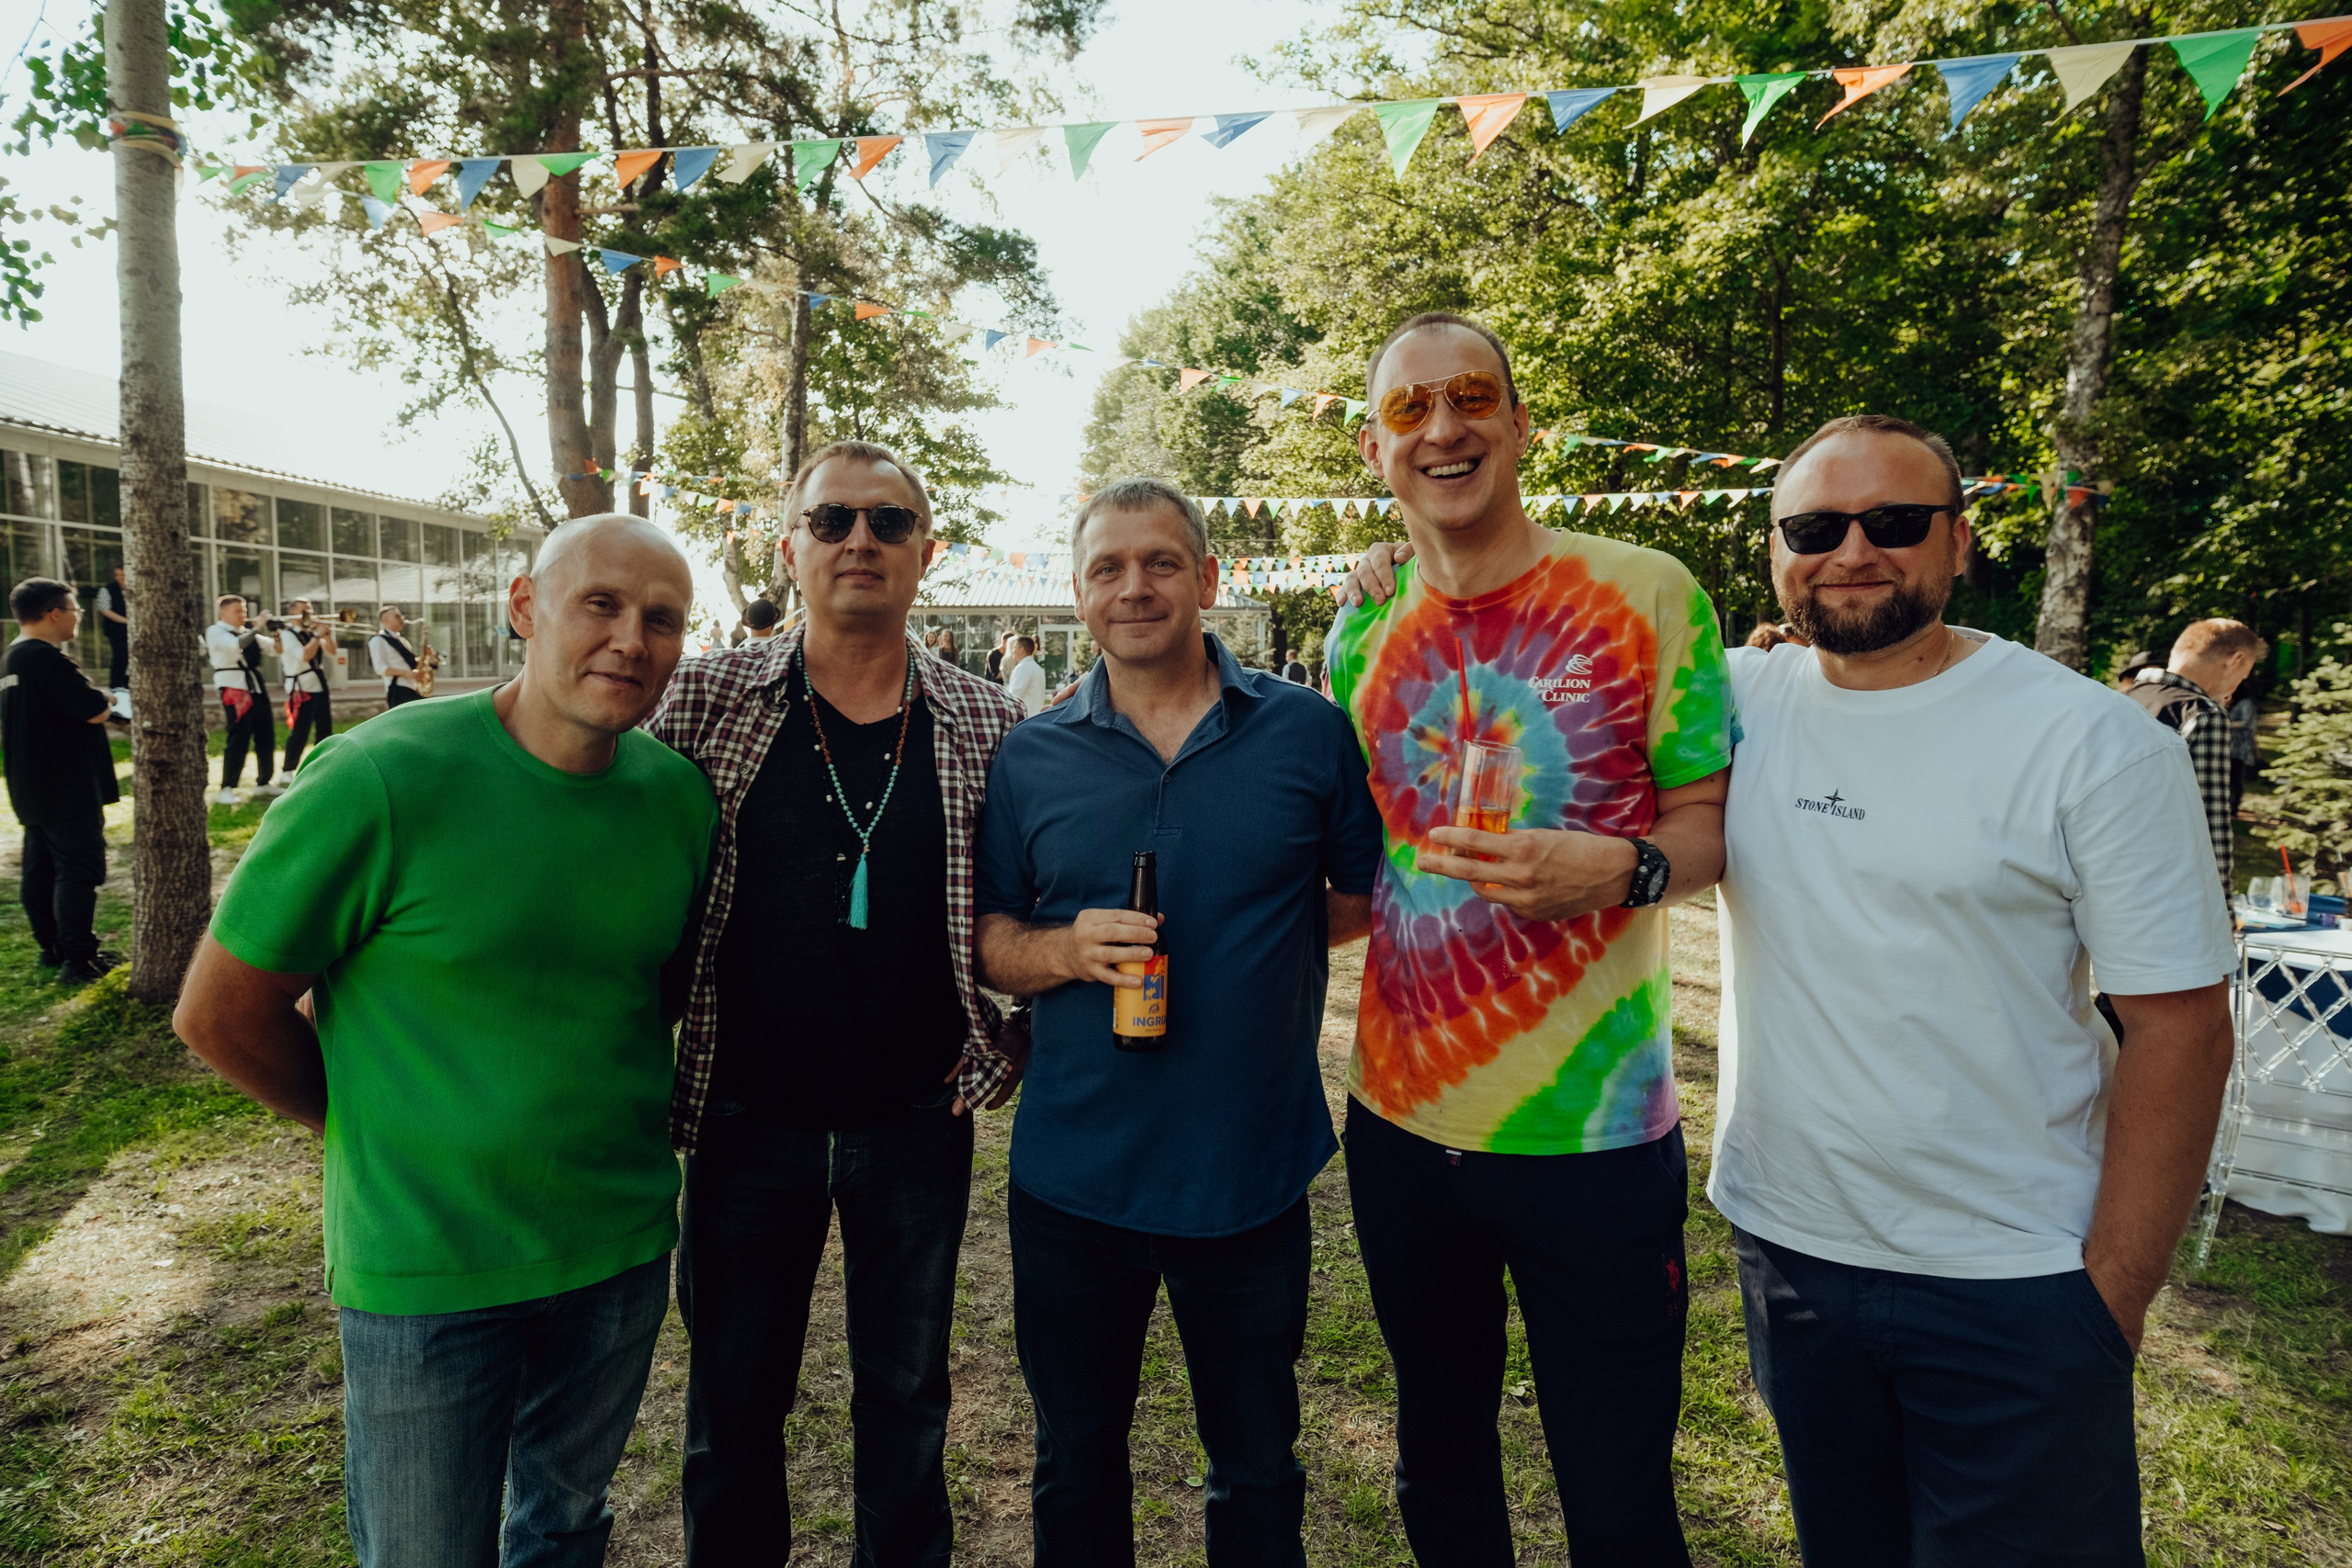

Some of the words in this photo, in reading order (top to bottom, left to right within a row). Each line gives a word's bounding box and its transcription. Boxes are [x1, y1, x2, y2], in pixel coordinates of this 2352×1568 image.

[1528, 676, 1591, 690] CARILION
[1541, 689, 1590, 703] CLINIC
[1794, 797, 1830, 814] STONE
[1831, 805, 1866, 820] ISLAND
